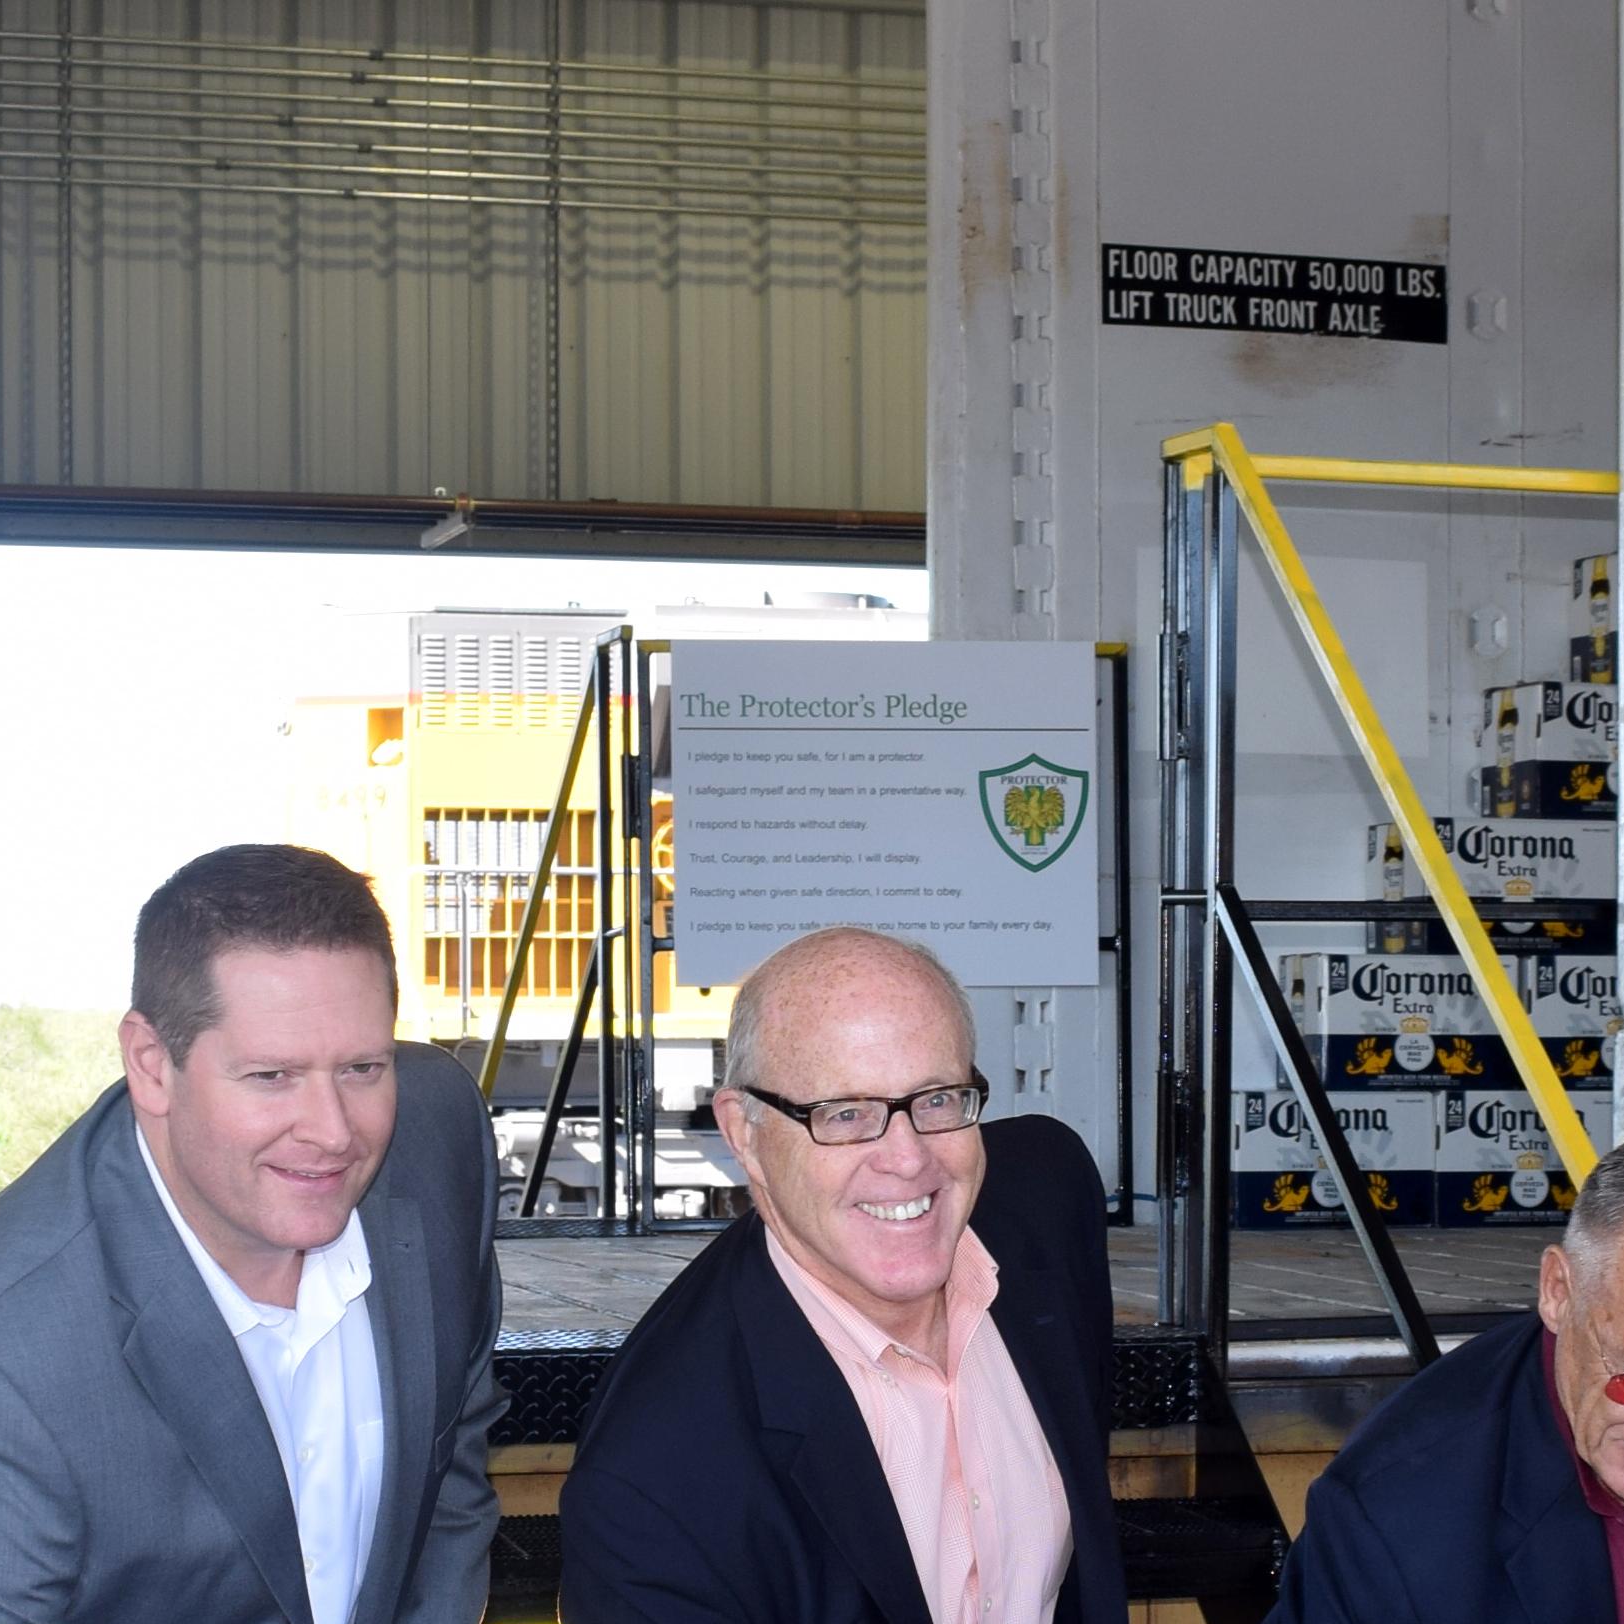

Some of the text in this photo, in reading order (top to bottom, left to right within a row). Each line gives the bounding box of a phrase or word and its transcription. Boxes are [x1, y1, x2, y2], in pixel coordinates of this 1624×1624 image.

[1108, 249, 1441, 299] FLOOR CAPACITY 50,000 LBS.
[1108, 289, 1384, 334] LIFT TRUCK FRONT AXLE
[1546, 690, 1560, 704] 24
[680, 693, 968, 725] The Protector's Pledge
[695, 752, 729, 763] pledge
[733, 753, 743, 761] to
[746, 752, 771, 763] keep
[775, 753, 793, 763] you
[797, 752, 821, 762] safe,
[825, 752, 838, 761] for
[1000, 776, 1068, 785] PROTECTOR
[695, 785, 747, 797] safeguard
[750, 785, 783, 797] myself
[786, 786, 806, 795] and
[809, 788, 824, 797] my
[828, 786, 854, 795] team
[857, 786, 867, 795] in
[879, 786, 942, 797] preventative
[945, 787, 967, 797] way.
[695, 819, 737, 831] respond
[741, 820, 751, 829] to
[754, 819, 796, 829] hazards
[799, 819, 836, 829] without
[838, 819, 868, 831] delay.
[1437, 824, 1576, 868] 24 Corona
[772, 853, 791, 863] and
[865, 853, 882, 863] will
[1497, 861, 1538, 877] Extra
[689, 887, 735, 899] Reacting
[738, 887, 766, 897] when
[770, 887, 797, 899] given
[801, 887, 823, 897] safe
[883, 887, 920, 896] commit
[924, 887, 933, 896] to
[696, 921, 732, 933] pledge
[735, 922, 745, 931] to
[748, 921, 773, 932] keep
[777, 922, 796, 932] you
[799, 921, 821, 930] safe
[877, 922, 895, 931] you
[897, 921, 927, 930] home
[930, 921, 940, 930] to
[943, 922, 965, 932] your
[969, 920, 998, 932] family
[1001, 922, 1029, 932] every
[1539, 966, 1553, 980] 24
[1331, 962, 1346, 977] 24
[1352, 962, 1474, 1006] Corona
[1393, 997, 1434, 1014] Extra
[1448, 1100, 1462, 1115] 24
[1248, 1099, 1263, 1113] 24
[1268, 1099, 1389, 1142] Cona
[1509, 1135, 1549, 1150] Extra
